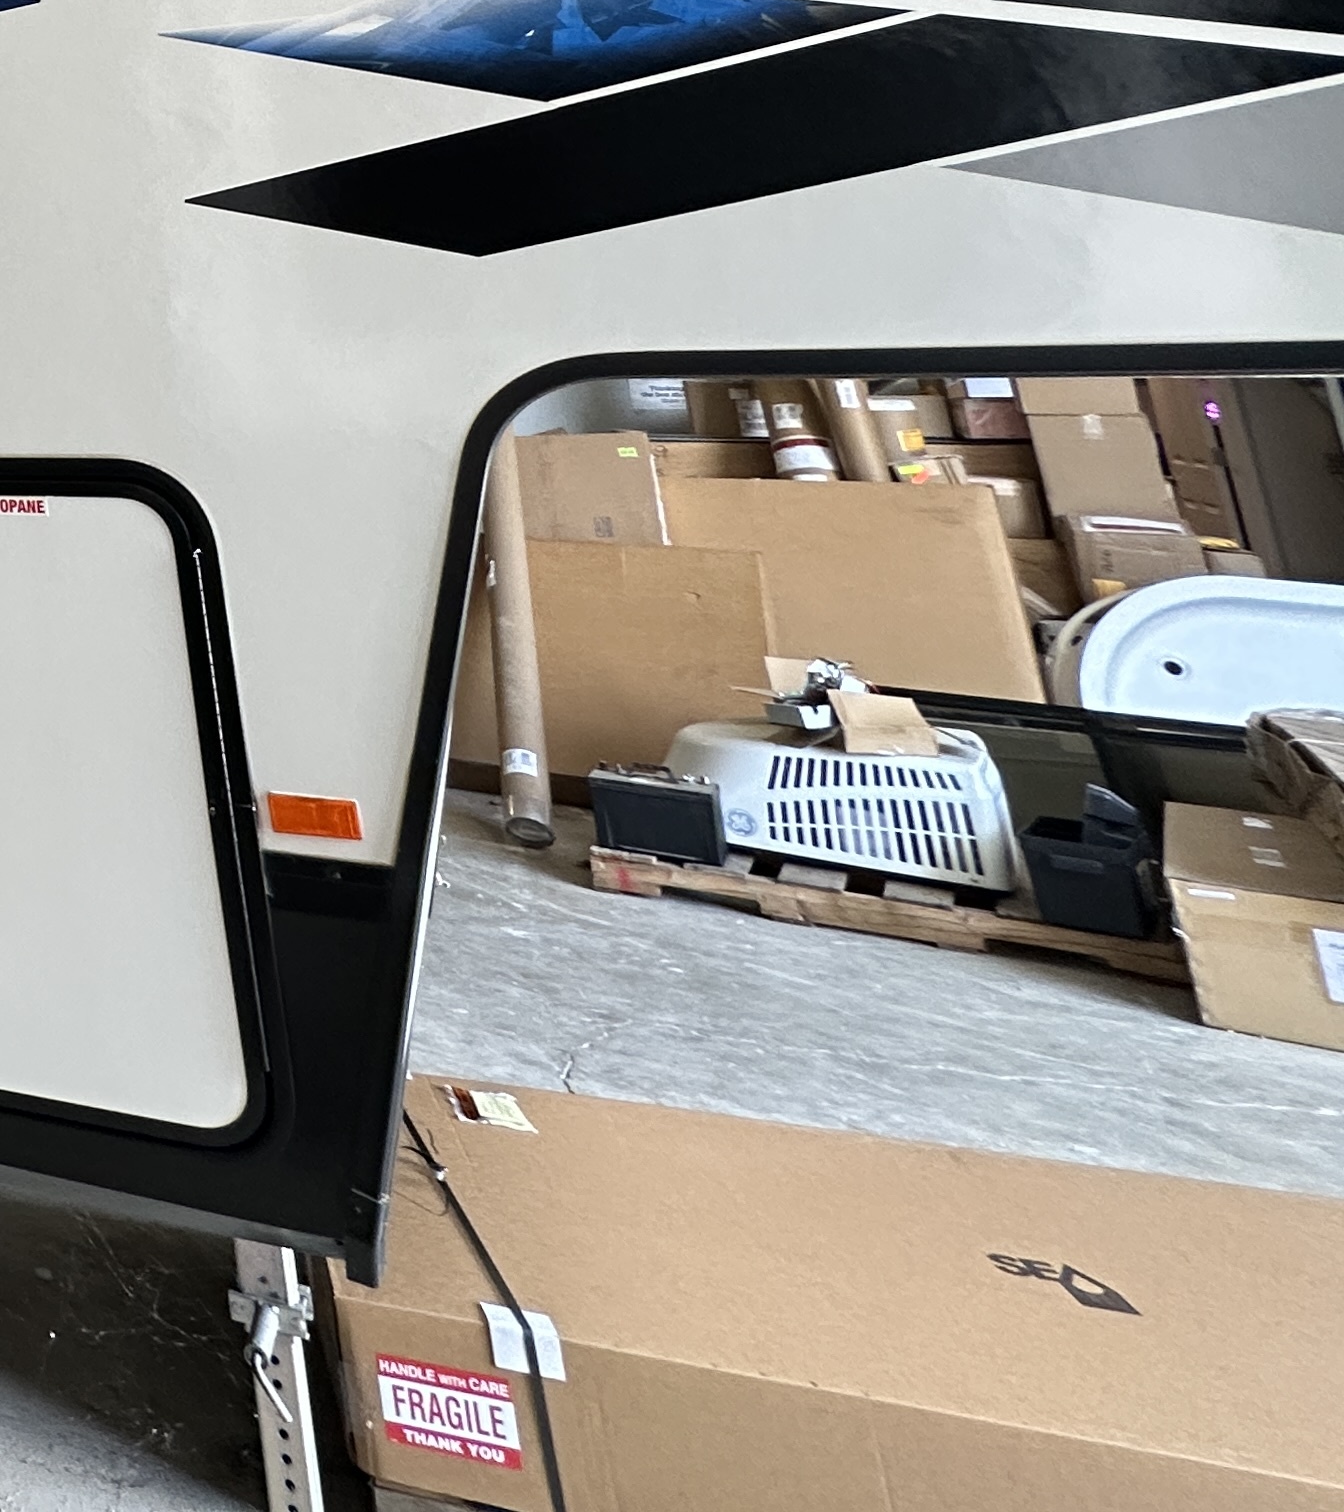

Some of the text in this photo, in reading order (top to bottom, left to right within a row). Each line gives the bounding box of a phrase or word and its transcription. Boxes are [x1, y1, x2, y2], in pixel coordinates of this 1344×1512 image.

[378, 1359, 510, 1398] HANDLE WITH CARE
[392, 1384, 507, 1440] FRAGILE
[402, 1428, 506, 1463] THANK YOU
